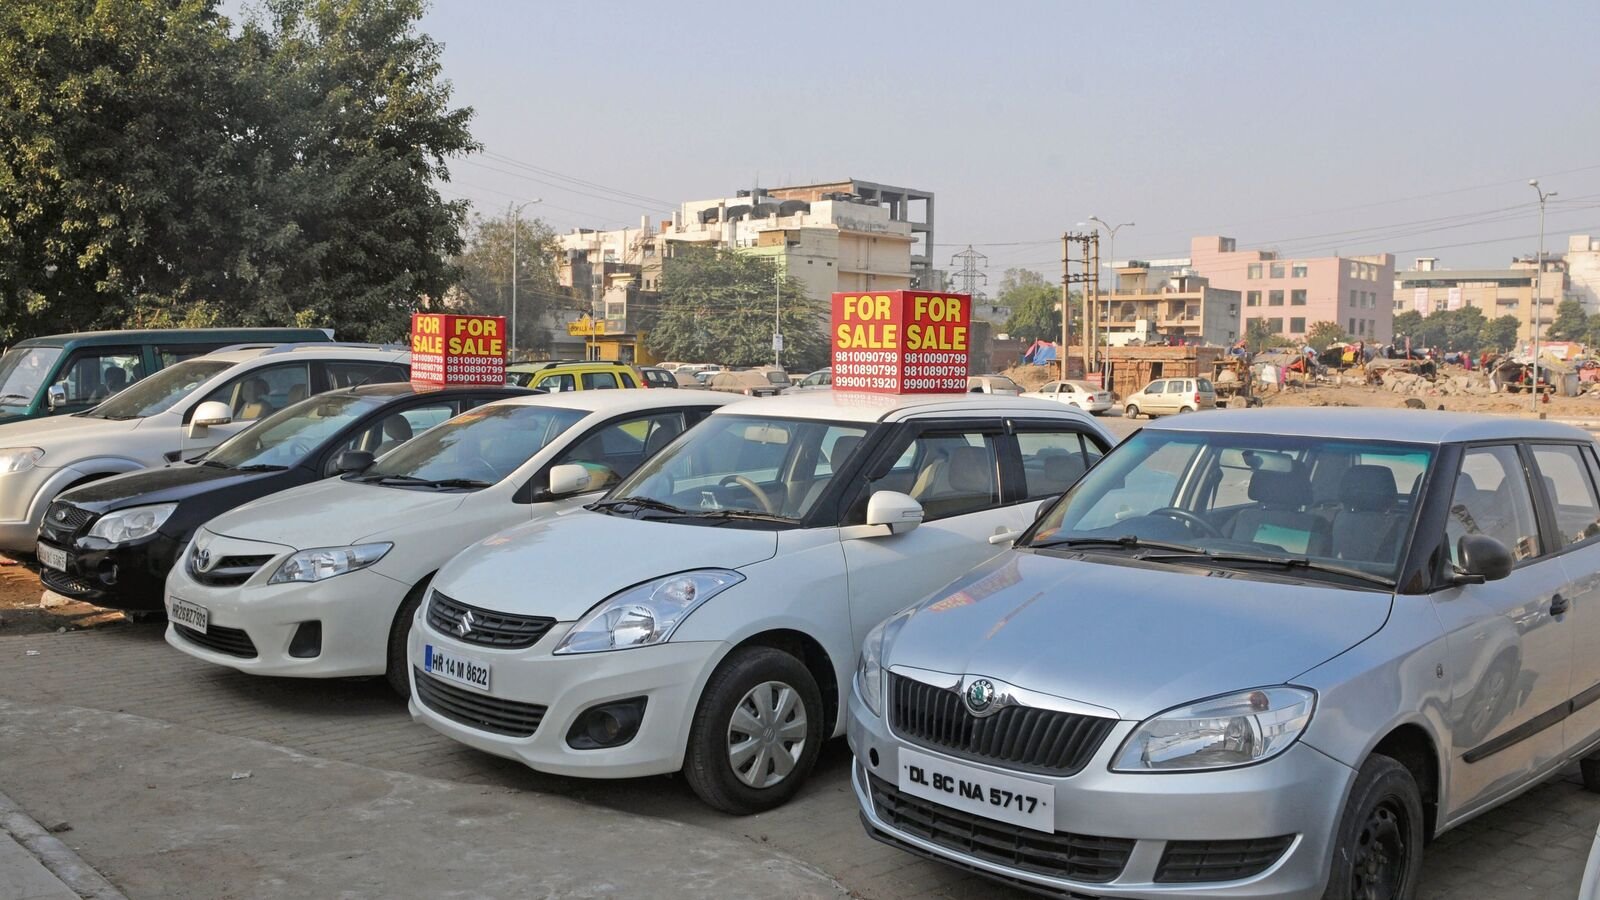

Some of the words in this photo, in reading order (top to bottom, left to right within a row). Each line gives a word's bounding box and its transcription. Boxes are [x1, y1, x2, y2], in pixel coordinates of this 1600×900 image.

[844, 296, 891, 321] FOR
[914, 297, 960, 322] FOR
[417, 317, 439, 334] FOR
[455, 319, 496, 336] FOR
[413, 335, 442, 353] SALE
[837, 324, 896, 349] SALE
[907, 324, 966, 350] SALE
[449, 337, 502, 355] SALE
[447, 356, 503, 365] 9810090799
[835, 352, 898, 363] 9810090799
[904, 352, 967, 364] 9810090799
[447, 365, 503, 373] 9810890799
[835, 364, 897, 375] 9810890799
[904, 365, 966, 376] 9810890799
[447, 374, 503, 382] 9990013920
[835, 376, 897, 388] 9990013920
[903, 378, 966, 389] 9990013920
[432, 653, 443, 672] HR
[446, 658, 455, 675] 14
[457, 661, 464, 678] M
[466, 664, 487, 686] 8622
[909, 765, 928, 786] DL
[932, 772, 954, 793] 8C
[958, 780, 984, 802] NA
[989, 787, 1038, 814] 5717
